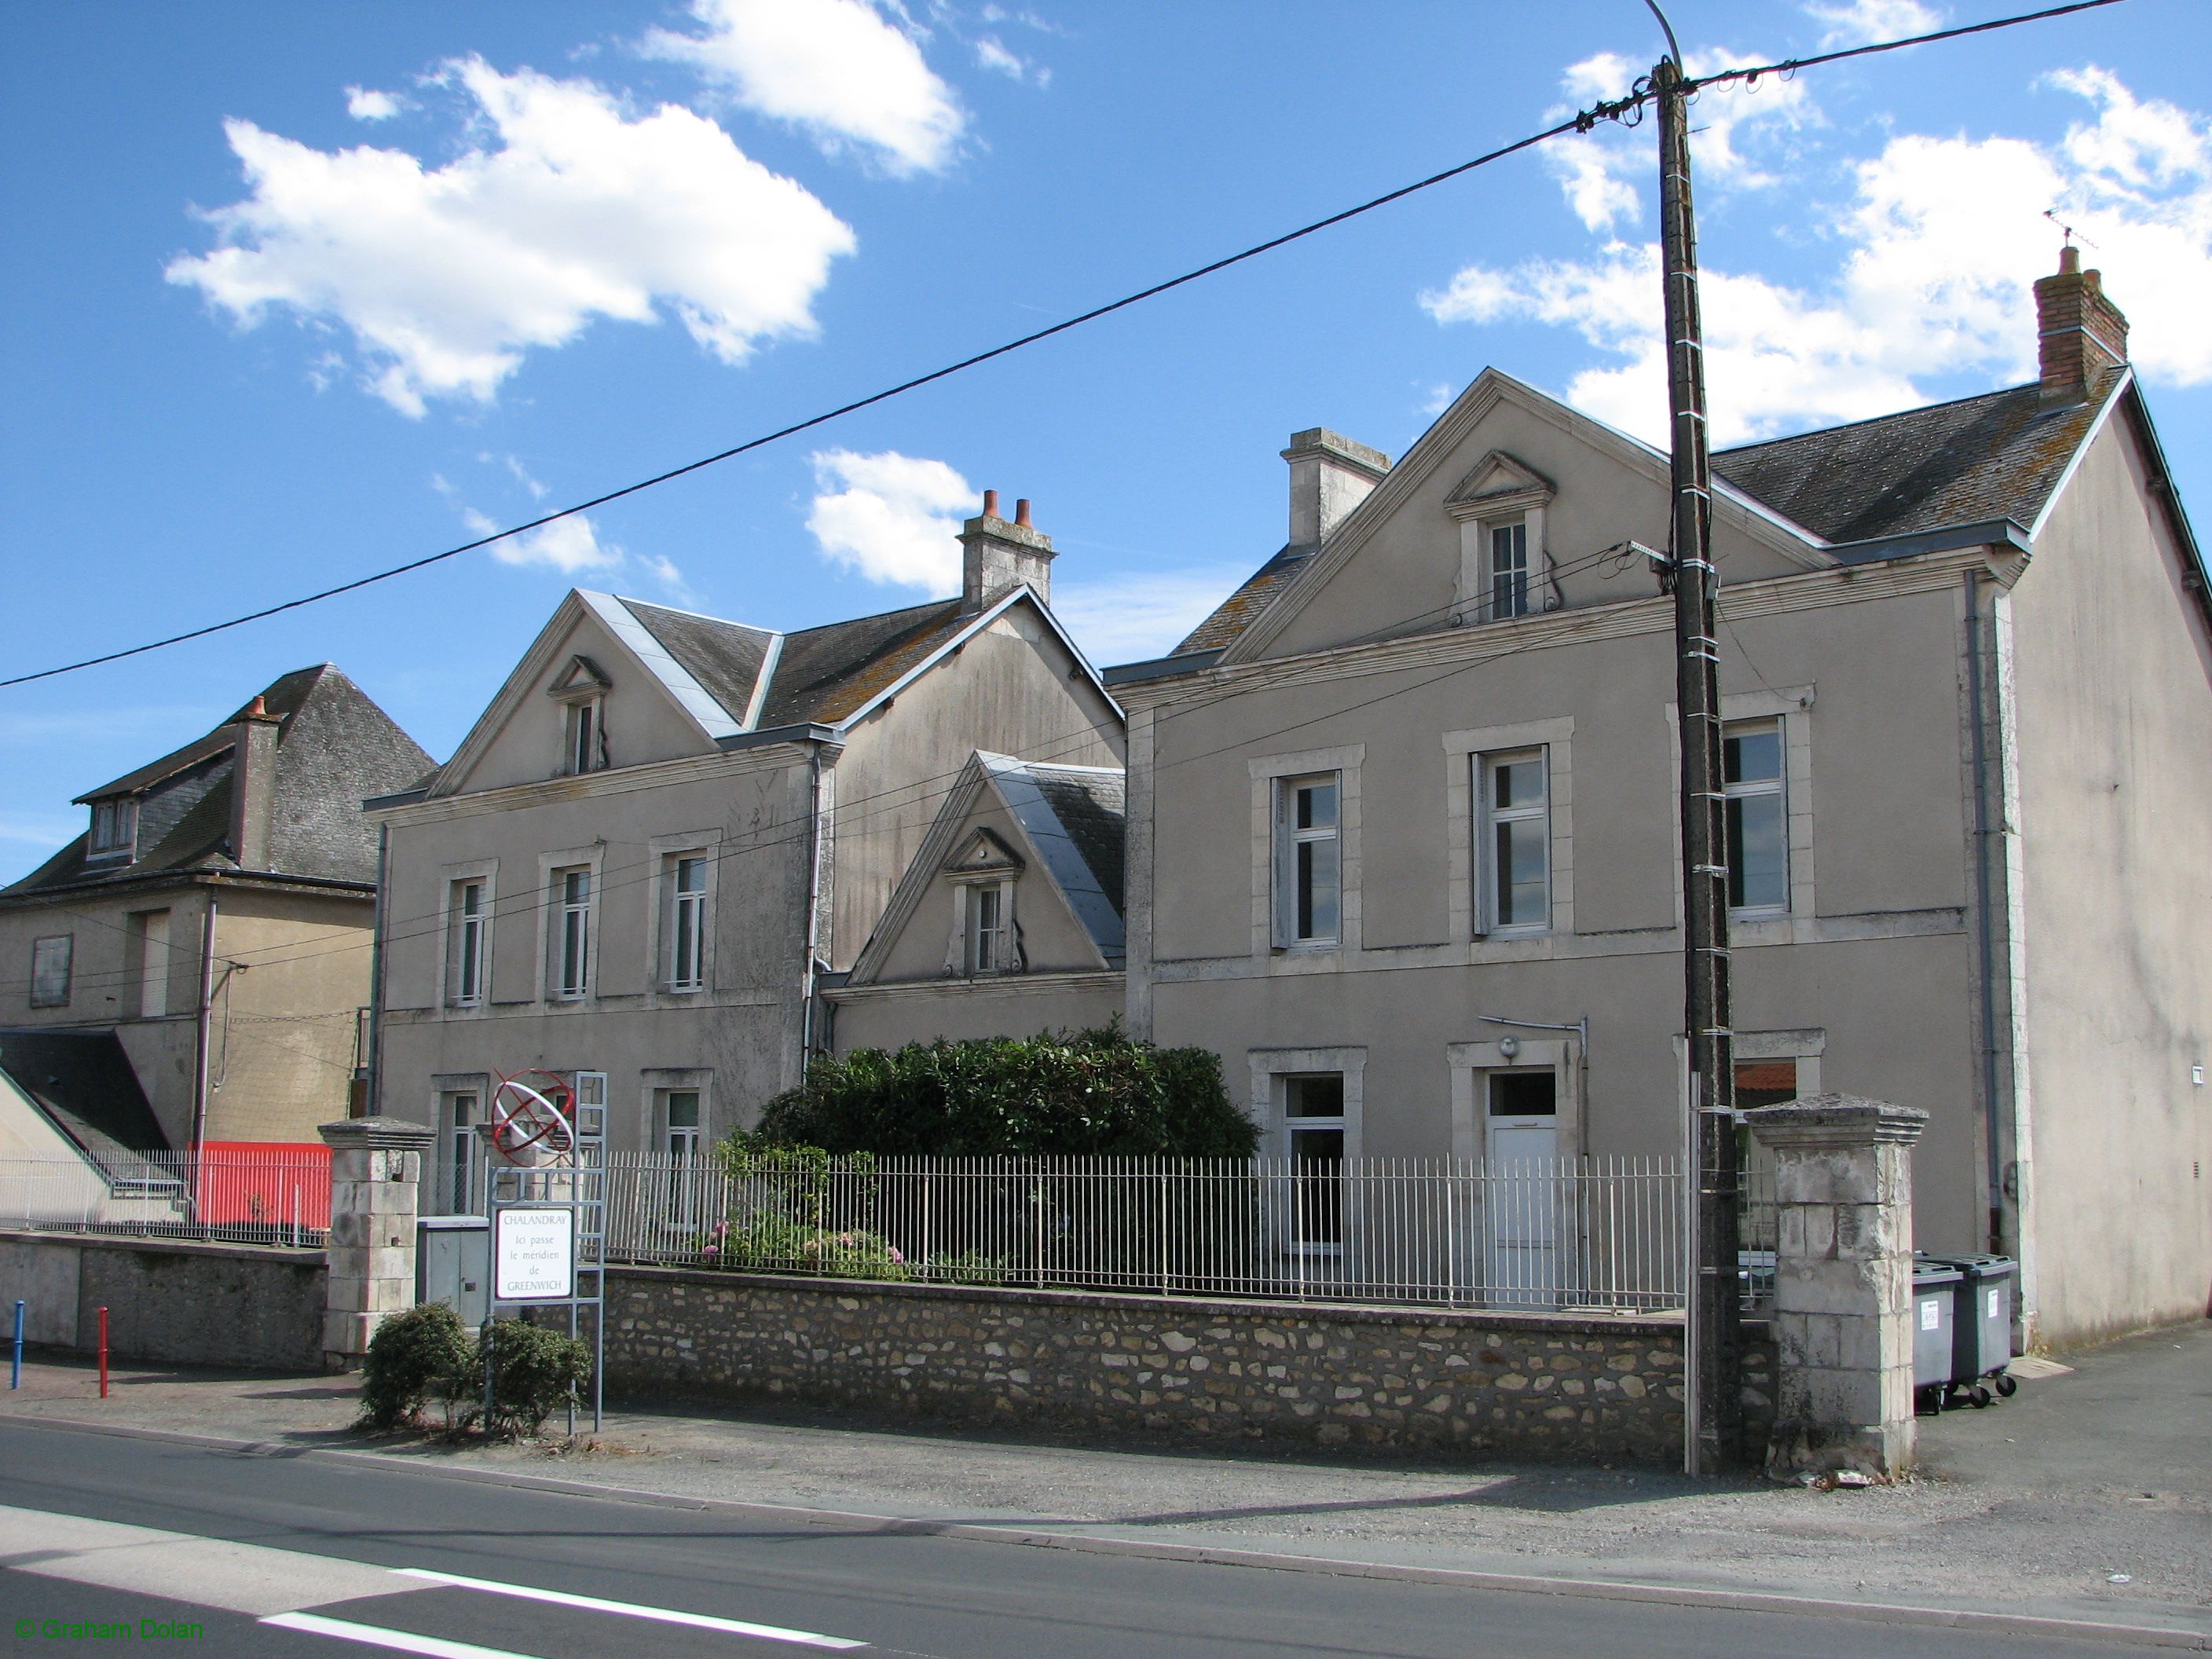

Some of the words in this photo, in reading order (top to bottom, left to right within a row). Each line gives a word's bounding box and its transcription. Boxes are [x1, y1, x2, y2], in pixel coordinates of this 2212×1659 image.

[504, 1215, 567, 1225] CHALANDRAY
[515, 1236, 526, 1244] Ici
[530, 1237, 555, 1247] passe
[510, 1251, 518, 1259] le
[522, 1250, 559, 1259] méridien
[529, 1265, 540, 1275] de
[507, 1280, 562, 1291] GREENWICH
